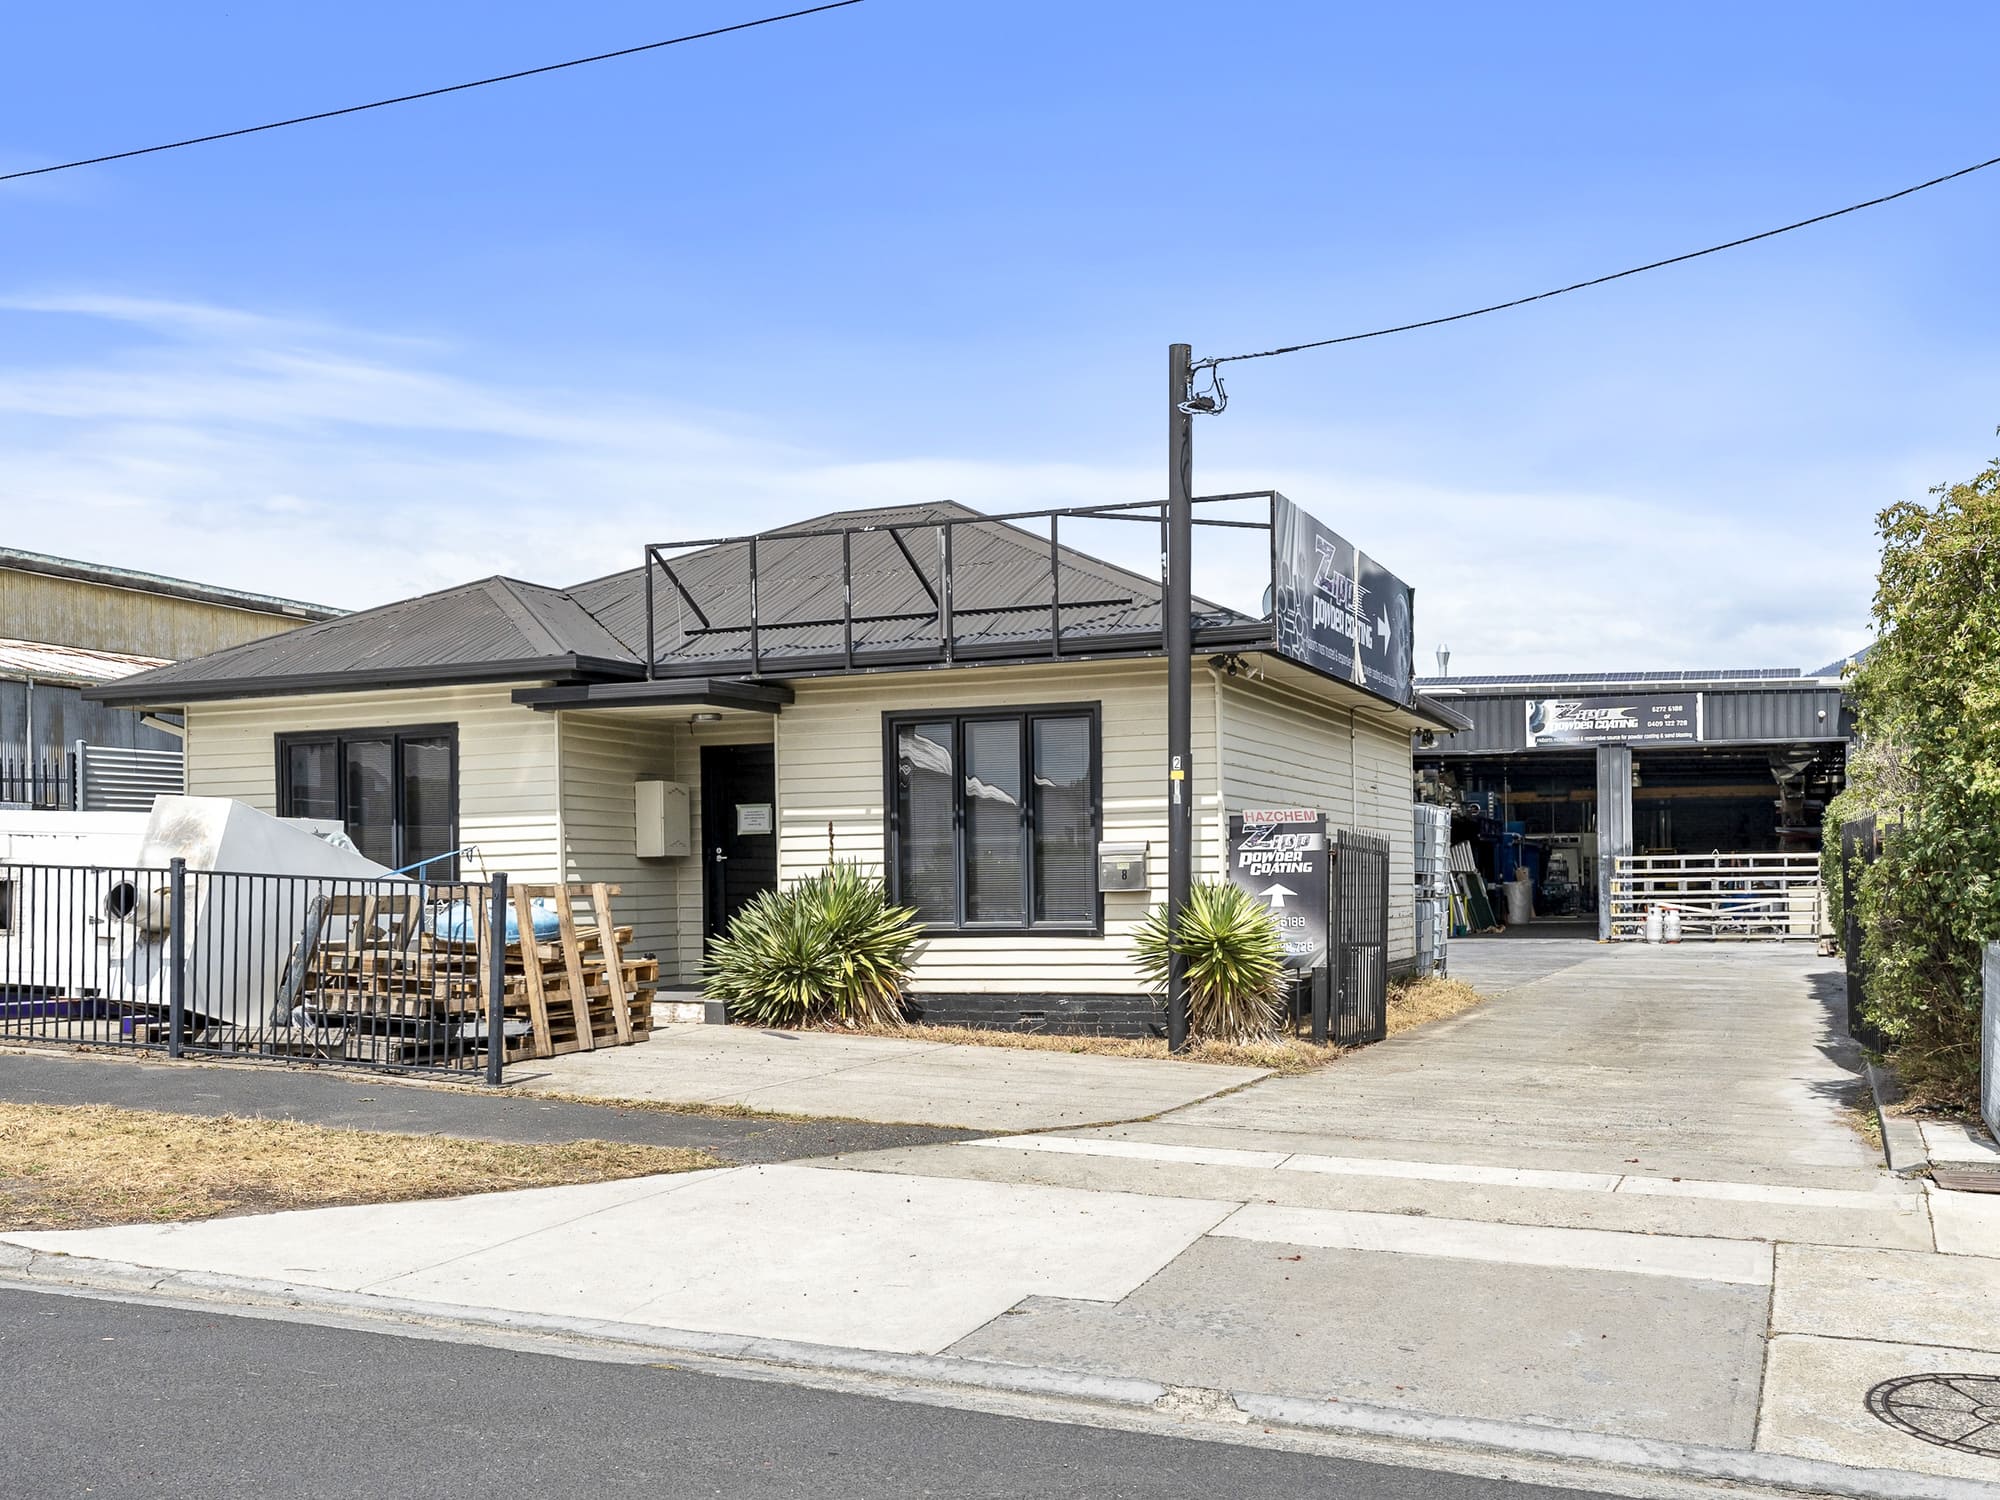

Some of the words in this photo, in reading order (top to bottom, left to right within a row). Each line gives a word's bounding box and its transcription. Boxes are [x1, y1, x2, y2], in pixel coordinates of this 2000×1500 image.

[1174, 757, 1180, 769] 2
[1244, 810, 1316, 823] HAZCHEM
[1121, 869, 1128, 880] 8
[1250, 861, 1313, 877] COATING
